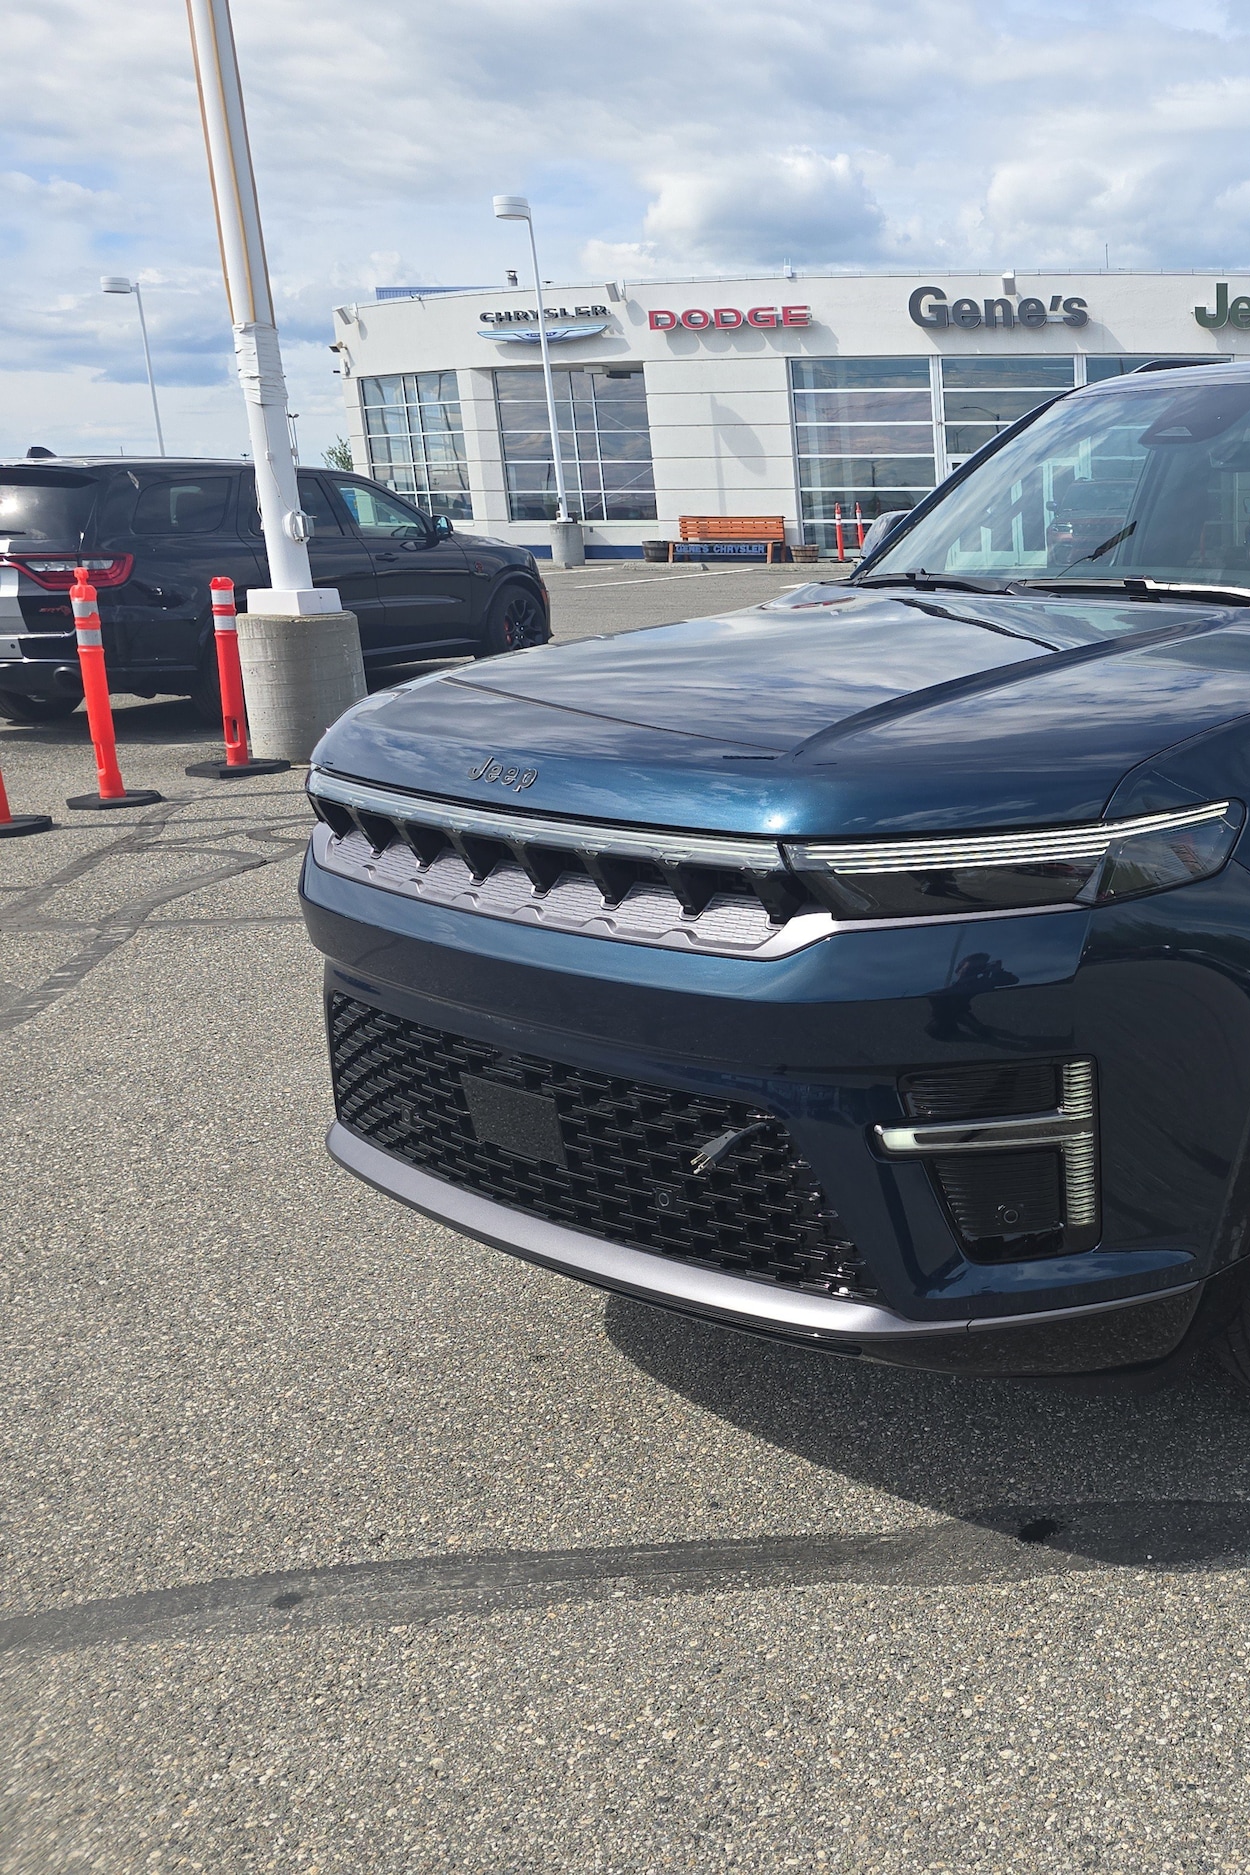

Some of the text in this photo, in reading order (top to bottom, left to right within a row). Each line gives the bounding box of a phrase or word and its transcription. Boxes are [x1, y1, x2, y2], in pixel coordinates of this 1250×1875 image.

[480, 305, 608, 322] CHRYSLER
[648, 305, 811, 331] DODGE
[909, 286, 1090, 329] Gene's
[675, 544, 765, 554] GENE'S CHRYSLER
[468, 756, 538, 792] Jeep
